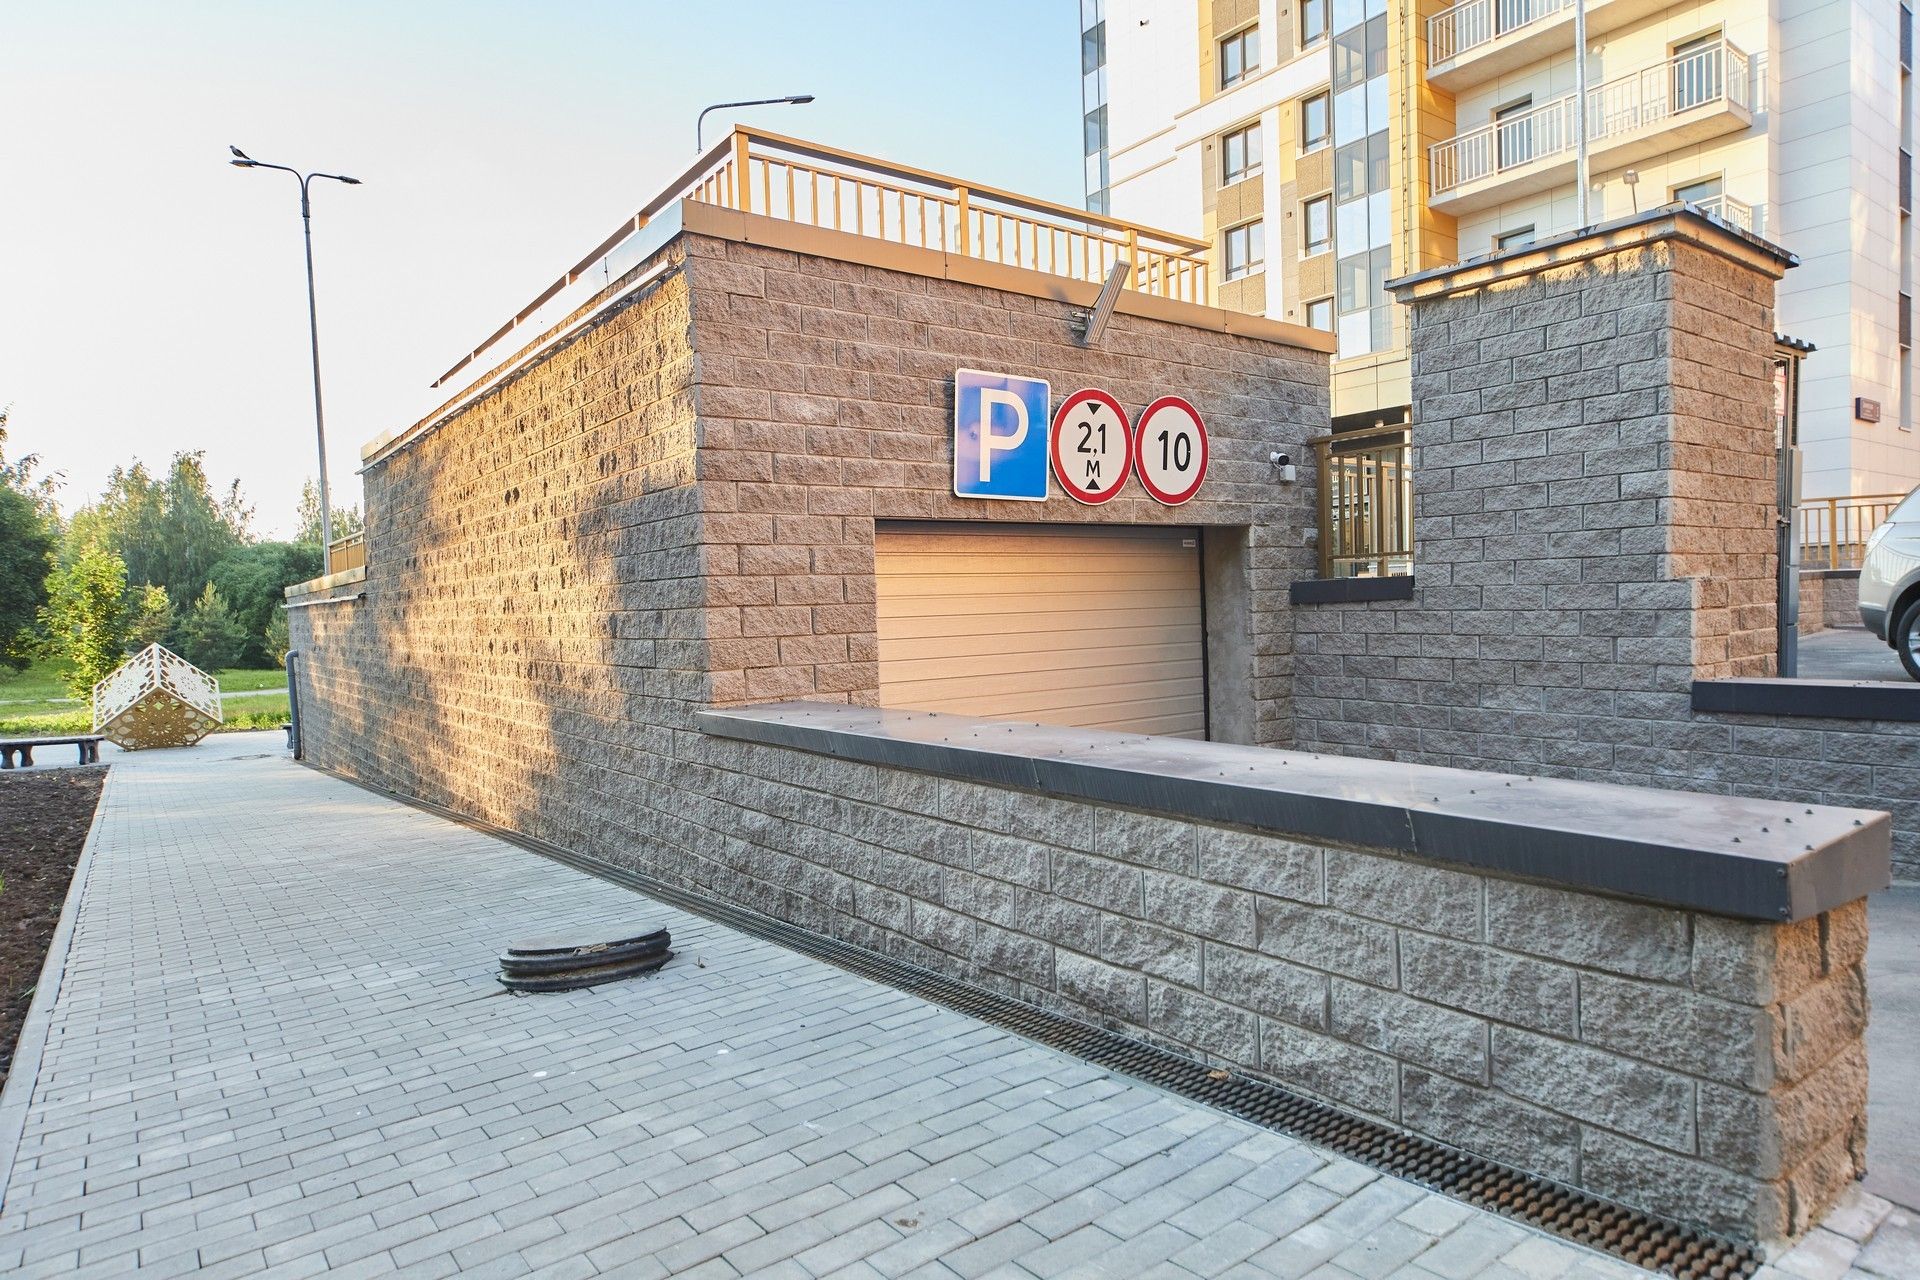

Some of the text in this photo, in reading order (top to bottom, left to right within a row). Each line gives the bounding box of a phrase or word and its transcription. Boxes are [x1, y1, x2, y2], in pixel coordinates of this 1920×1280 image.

[979, 387, 1029, 483] P
[1077, 421, 1107, 457] 2,1
[1157, 430, 1191, 472] 10
